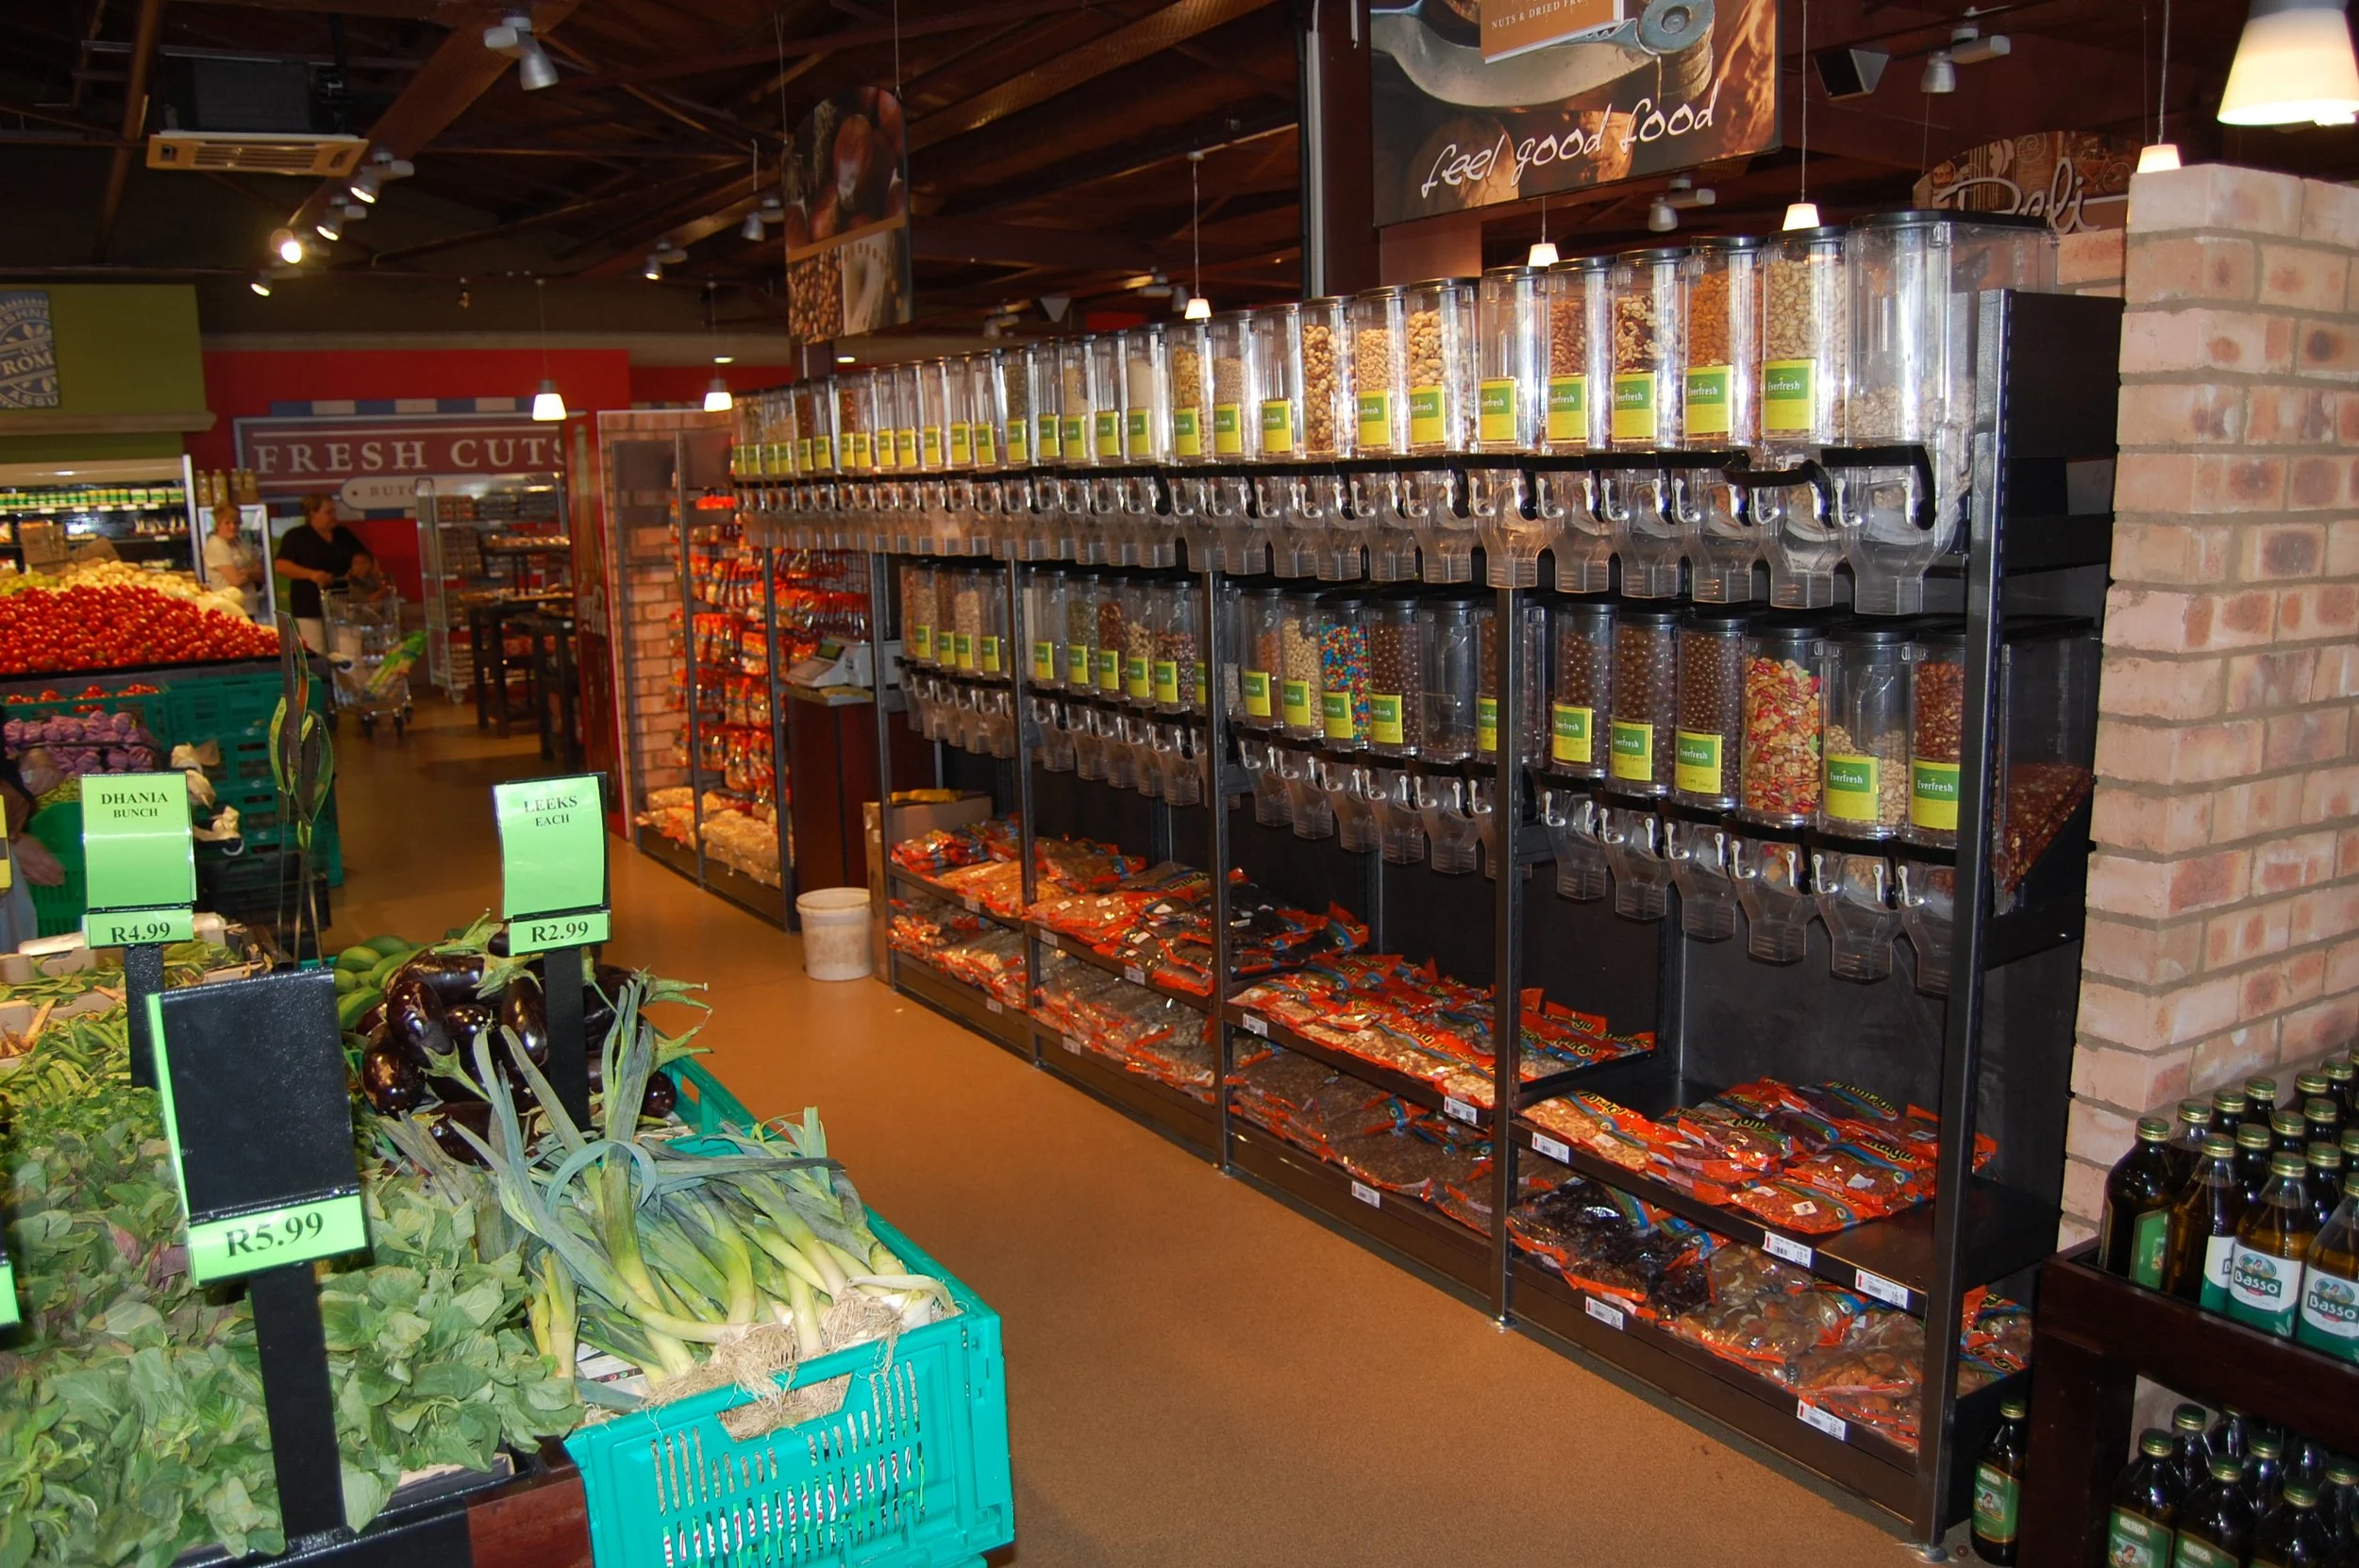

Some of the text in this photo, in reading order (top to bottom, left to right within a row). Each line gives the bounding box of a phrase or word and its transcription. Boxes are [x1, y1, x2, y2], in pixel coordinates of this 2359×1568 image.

[1492, 14, 1516, 30] NUTS
[1529, 2, 1560, 18] DRIED
[1421, 78, 1720, 198] feel good food
[0, 350, 54, 375] ROM
[253, 441, 428, 472] FRESH
[1830, 772, 1864, 785] Everfresh
[1917, 779, 1953, 793] Everfresh
[101, 792, 169, 805] DHANIA
[524, 794, 578, 813] LEEKS
[113, 808, 159, 818] BUNCH
[535, 813, 571, 827] EACH
[110, 921, 172, 943] R4.99
[531, 921, 590, 942] R2.99
[226, 1210, 325, 1259] R5.99
[2234, 1270, 2279, 1294] Basso
[2309, 1294, 2357, 1320] Basso
